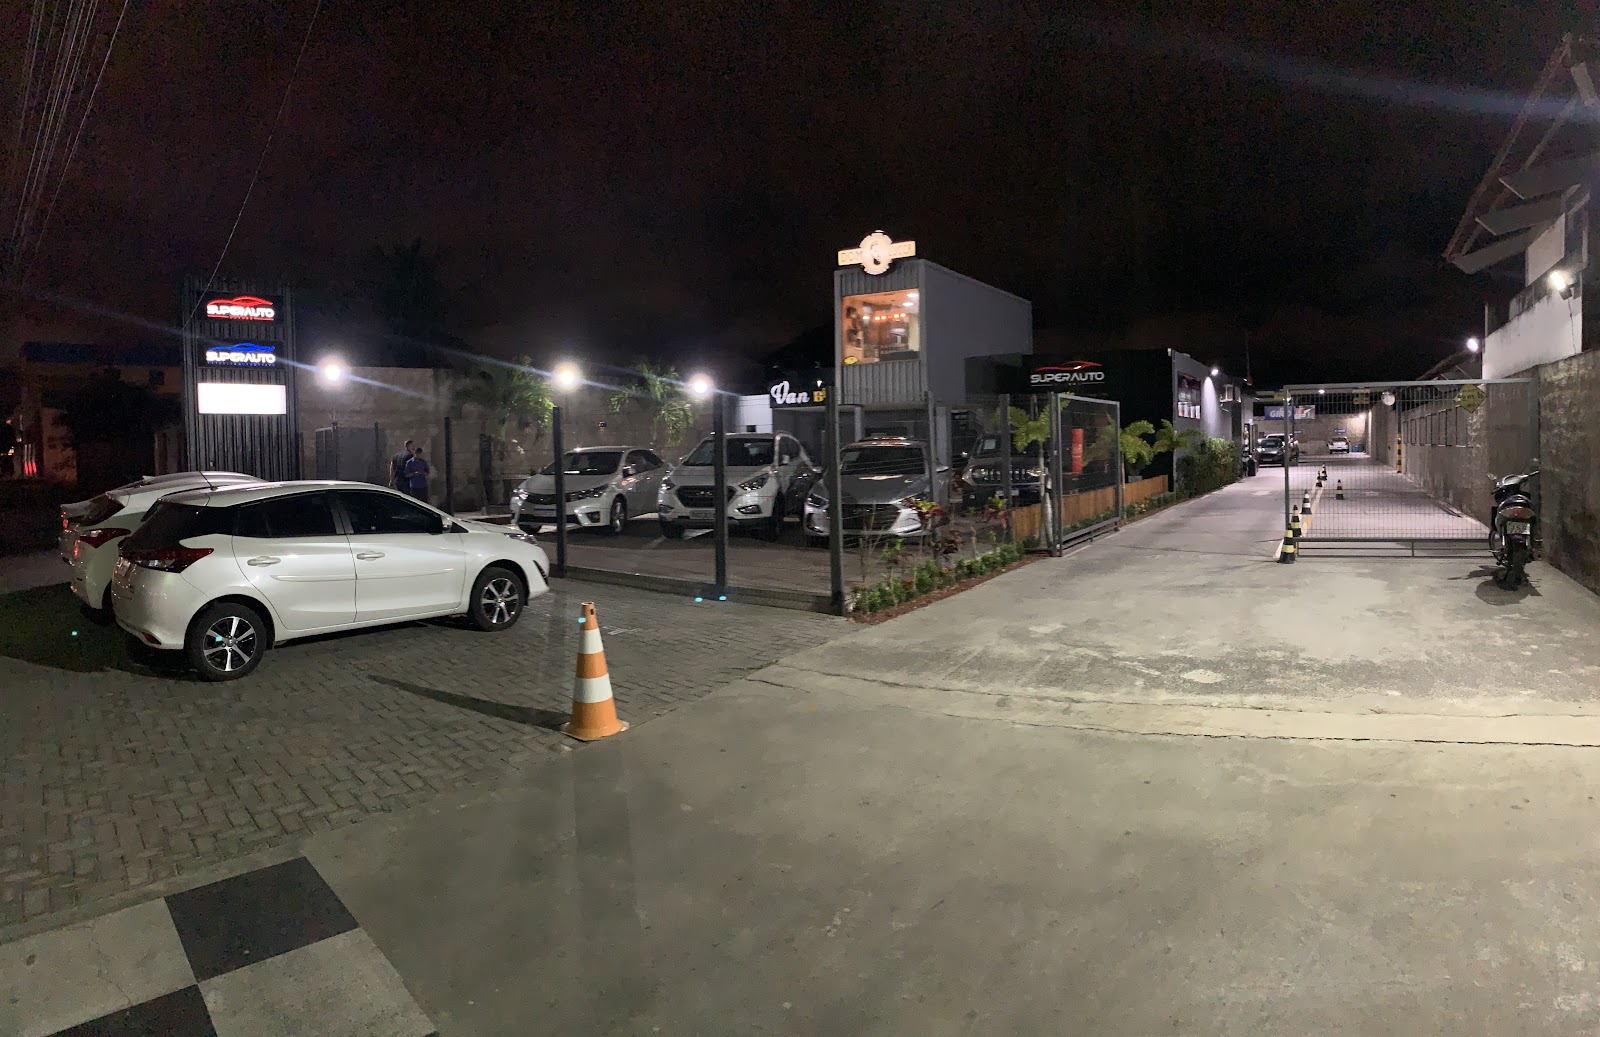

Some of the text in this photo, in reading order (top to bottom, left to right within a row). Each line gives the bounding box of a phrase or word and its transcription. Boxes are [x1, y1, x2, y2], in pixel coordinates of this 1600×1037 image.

[207, 304, 275, 318] SUPERAUTO
[206, 351, 276, 364] SUPERAUTO
[1030, 371, 1105, 384] SUPERAUTO
[770, 380, 810, 404] Van
